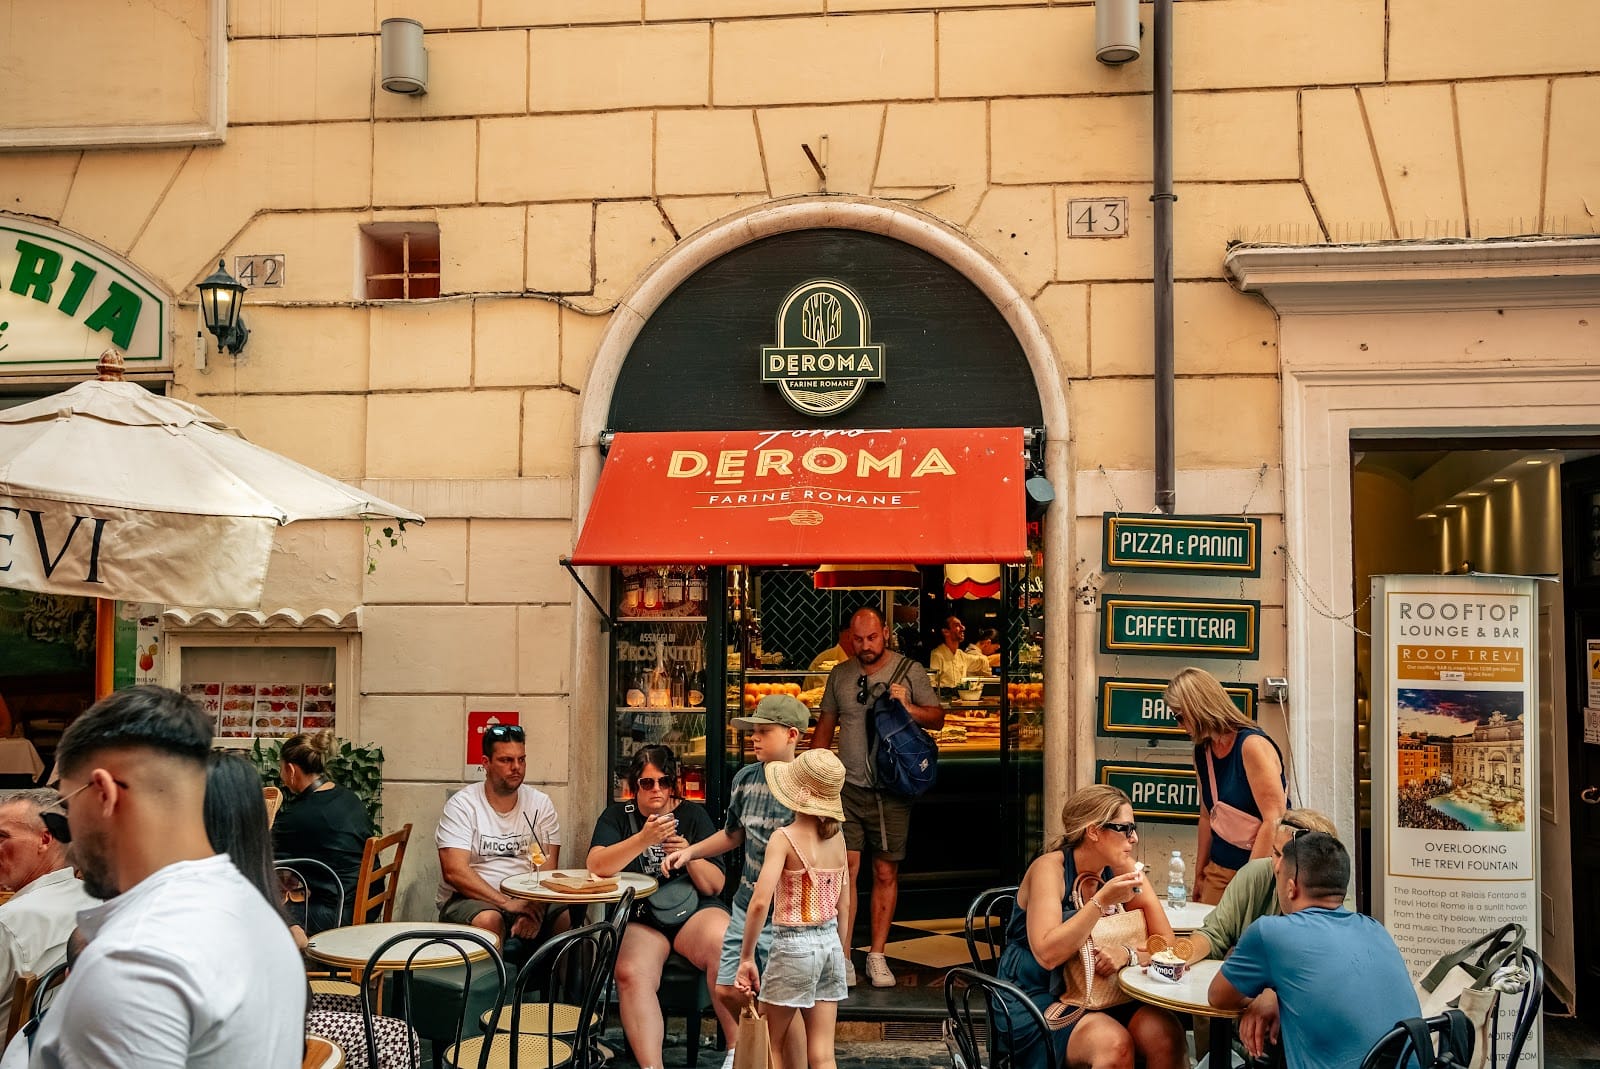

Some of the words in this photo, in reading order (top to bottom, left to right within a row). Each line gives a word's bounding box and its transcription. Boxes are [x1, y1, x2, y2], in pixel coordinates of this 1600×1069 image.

[1075, 204, 1120, 232] 43
[239, 258, 279, 285] 42
[0, 239, 142, 350] RIA
[769, 354, 874, 376] DEROMA
[820, 380, 855, 388] ROMANE
[667, 447, 957, 485] DEROMA
[709, 491, 790, 505] FARINE
[804, 490, 902, 505] ROMANE
[1120, 532, 1173, 555] PIZZA
[1188, 535, 1243, 558] PANINI
[1400, 602, 1519, 622] ROOFTOP
[1124, 615, 1236, 640] CAFFETTERIA
[1401, 625, 1469, 637] LOUNGE
[1476, 627, 1486, 638] &
[1494, 627, 1519, 639] BAR
[1403, 648, 1459, 660] ROOF
[1468, 650, 1519, 662] TREVI
[1425, 842, 1507, 854] OVERLOOKING
[1411, 858, 1431, 868] THE
[1434, 859, 1464, 869] TREVI
[1468, 861, 1518, 870] FOUNTAIN
[1393, 886, 1410, 895] The
[1412, 888, 1447, 898] Rooftop
[1461, 891, 1486, 899] Relais
[1394, 898, 1414, 907] Trevi
[1416, 900, 1438, 909] Hotel
[1440, 902, 1466, 911] Rome
[1484, 903, 1504, 911] sunlit
[1393, 909, 1414, 918] from
[1416, 911, 1431, 920] the
[1432, 913, 1448, 923] city
[1393, 922, 1411, 930] and
[1441, 925, 1456, 933] The
[1457, 926, 1488, 936] Rooftop
[1417, 935, 1456, 945] provides
[1398, 946, 1446, 957] anoramic
